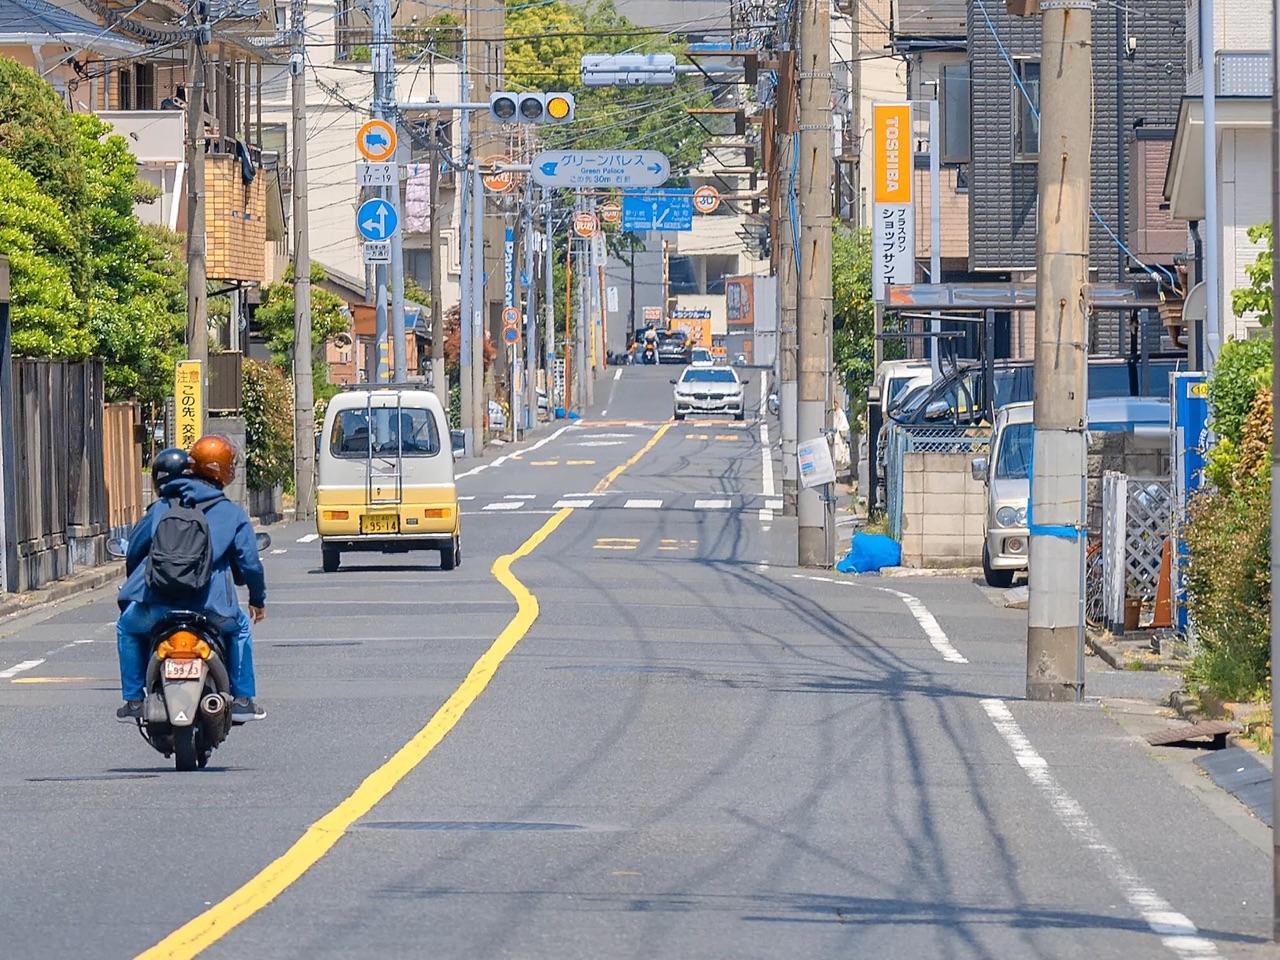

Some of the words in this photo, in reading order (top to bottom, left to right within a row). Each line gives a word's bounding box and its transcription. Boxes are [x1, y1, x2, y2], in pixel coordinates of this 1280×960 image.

[560, 154, 645, 167] グリーンパレス
[885, 116, 900, 192] TOSHIBA
[897, 208, 906, 253] プラスワン
[504, 241, 514, 309] Panason
